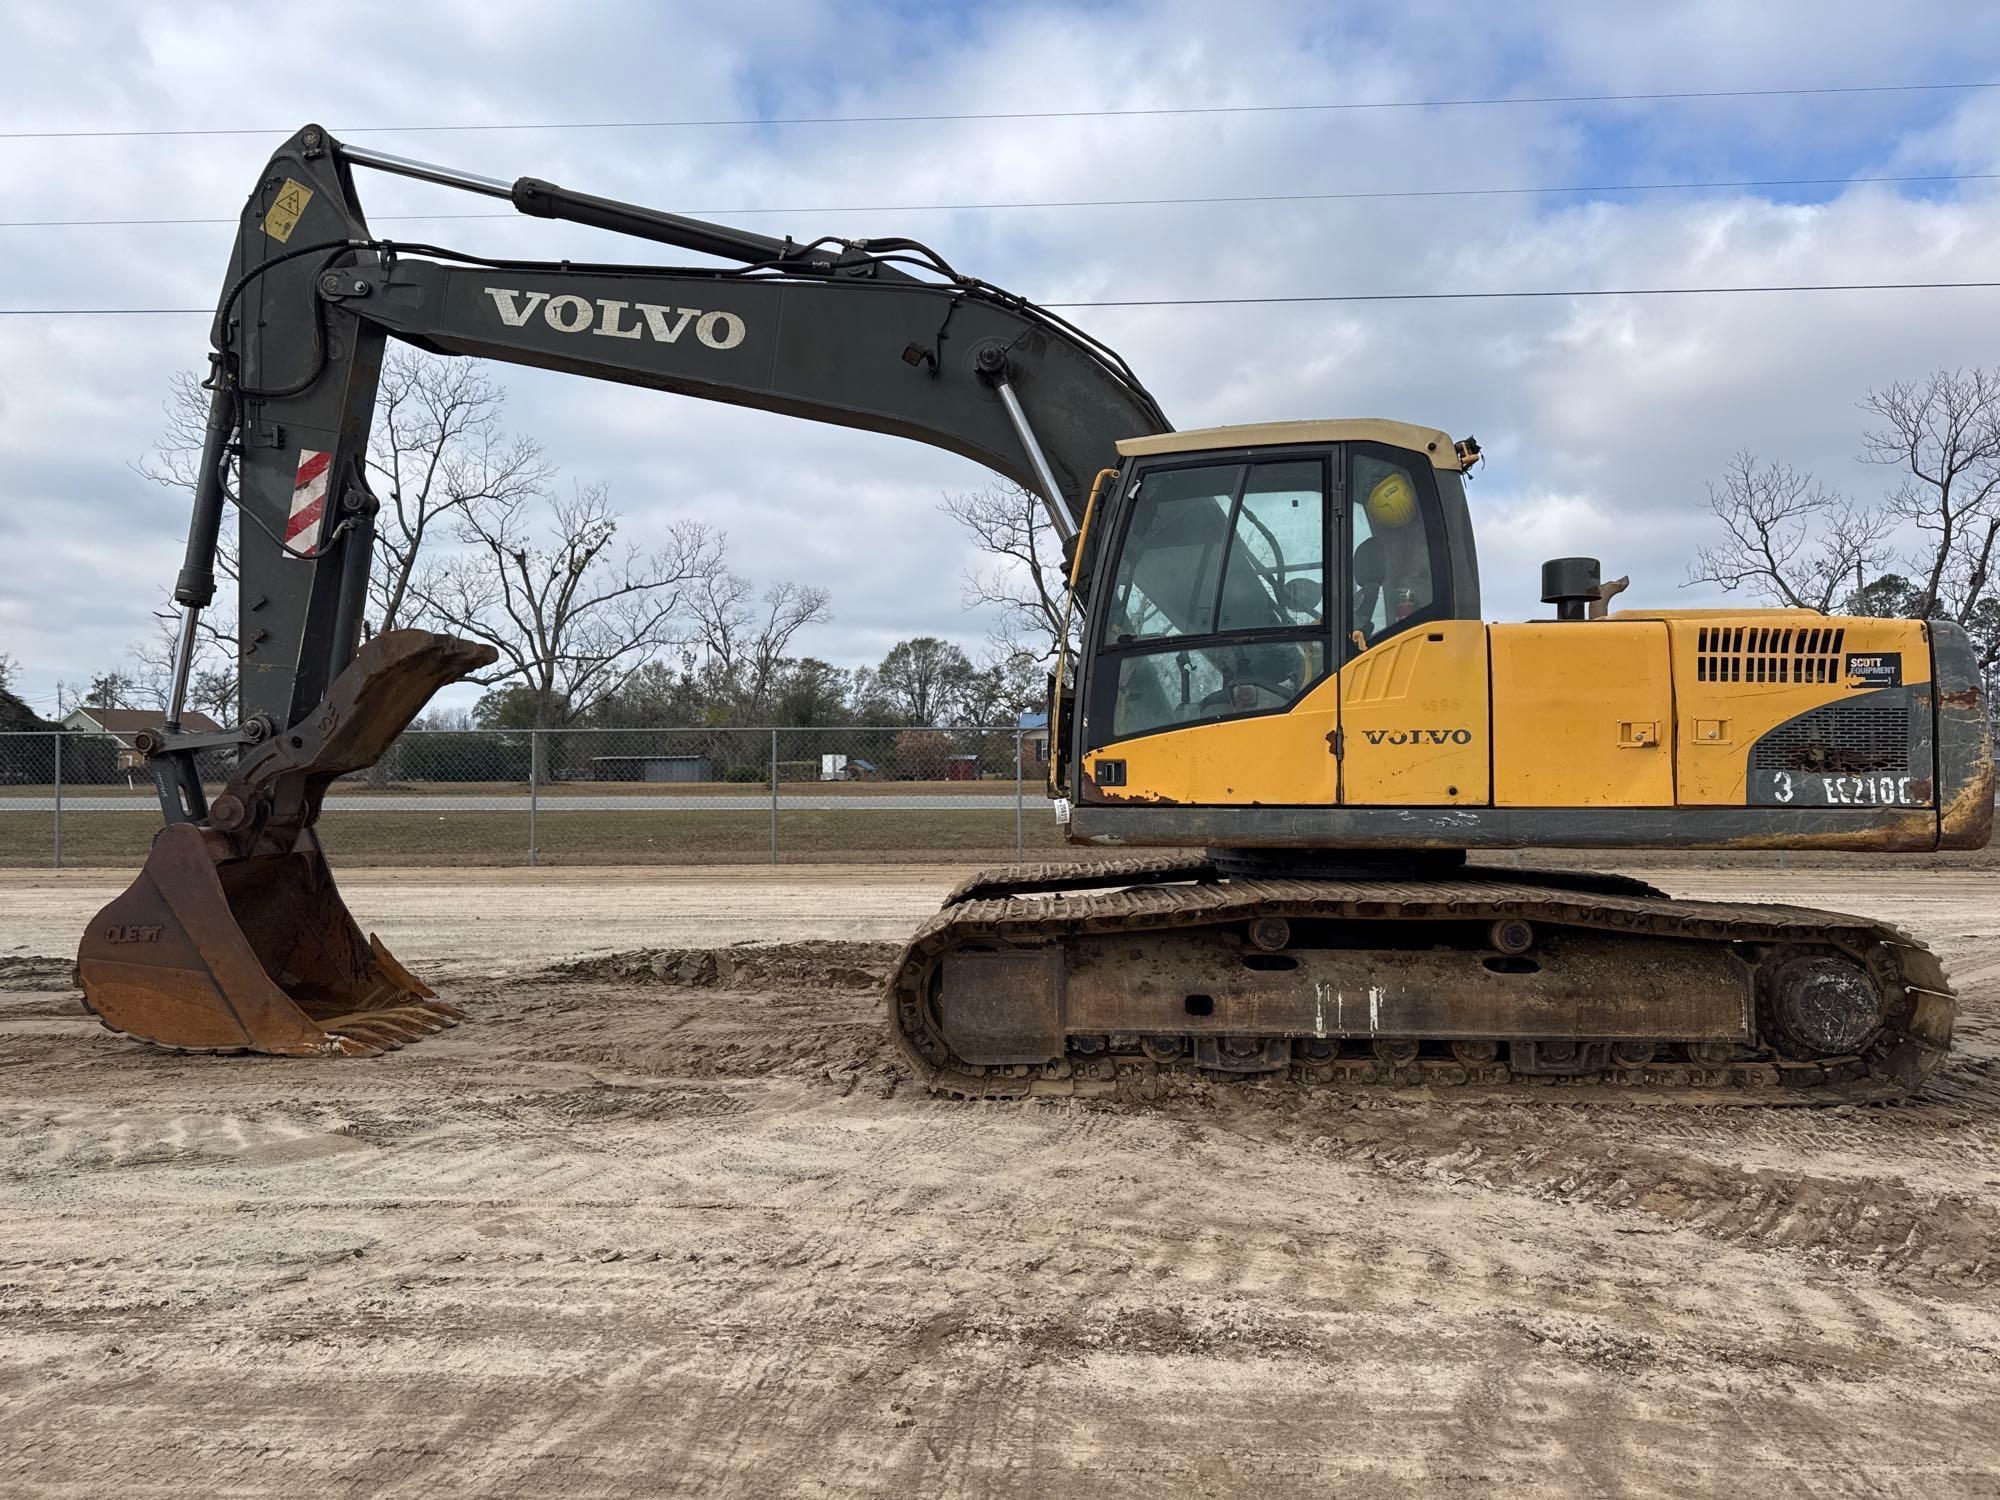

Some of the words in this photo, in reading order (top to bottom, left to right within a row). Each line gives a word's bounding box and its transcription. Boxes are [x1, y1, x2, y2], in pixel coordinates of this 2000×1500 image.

[484, 287, 746, 350] VOLVO
[1850, 657, 1882, 667] SCOTT
[1850, 666, 1896, 675] EQUIPMENT
[1361, 729, 1472, 744] VOLVO
[1773, 771, 1793, 803] 3
